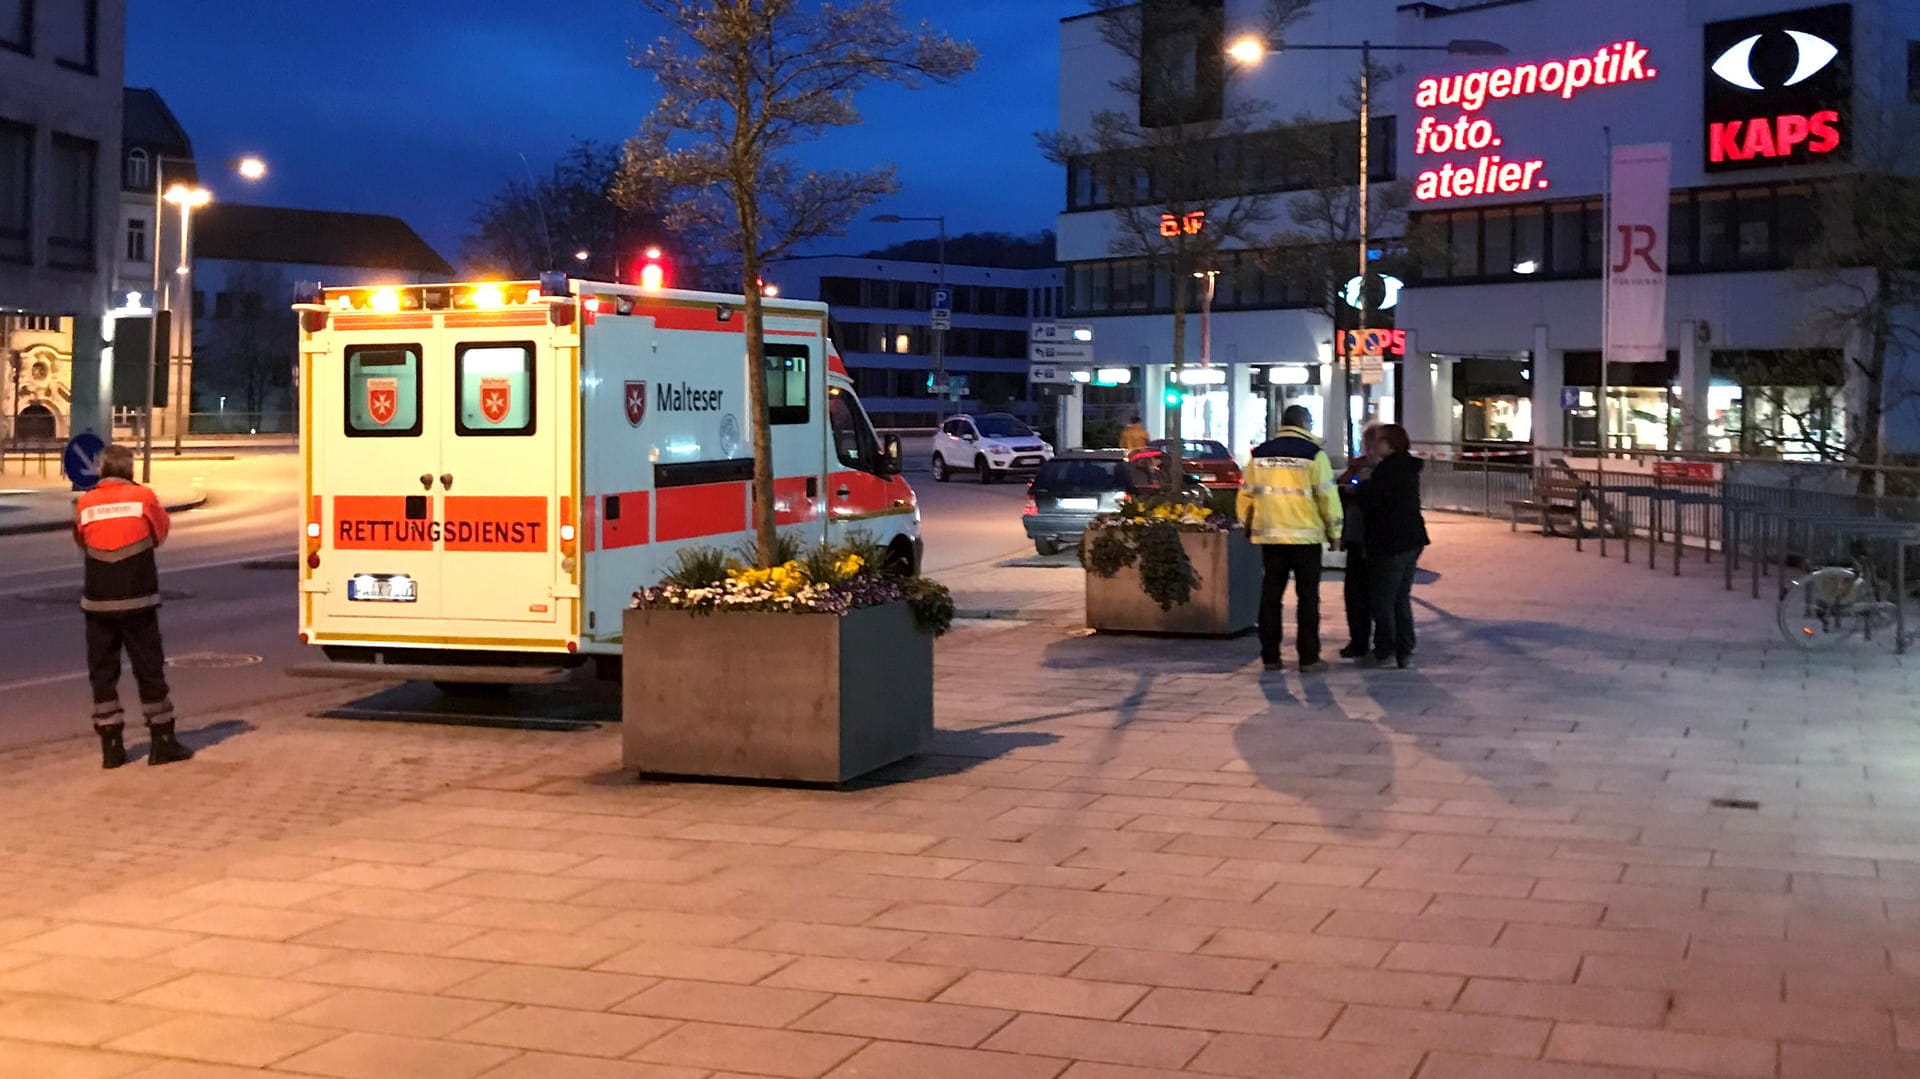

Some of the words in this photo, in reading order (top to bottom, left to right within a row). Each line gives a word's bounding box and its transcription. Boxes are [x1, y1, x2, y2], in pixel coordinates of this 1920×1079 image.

[1415, 40, 1656, 111] augenoptik.
[1415, 115, 1502, 154] foto.
[1709, 109, 1840, 162] KAPS
[1415, 155, 1549, 200] atelier.
[1612, 224, 1663, 273] JR
[935, 291, 947, 307] P
[656, 381, 724, 413] Malteser
[339, 519, 541, 544] RETTUNGSDIENST
